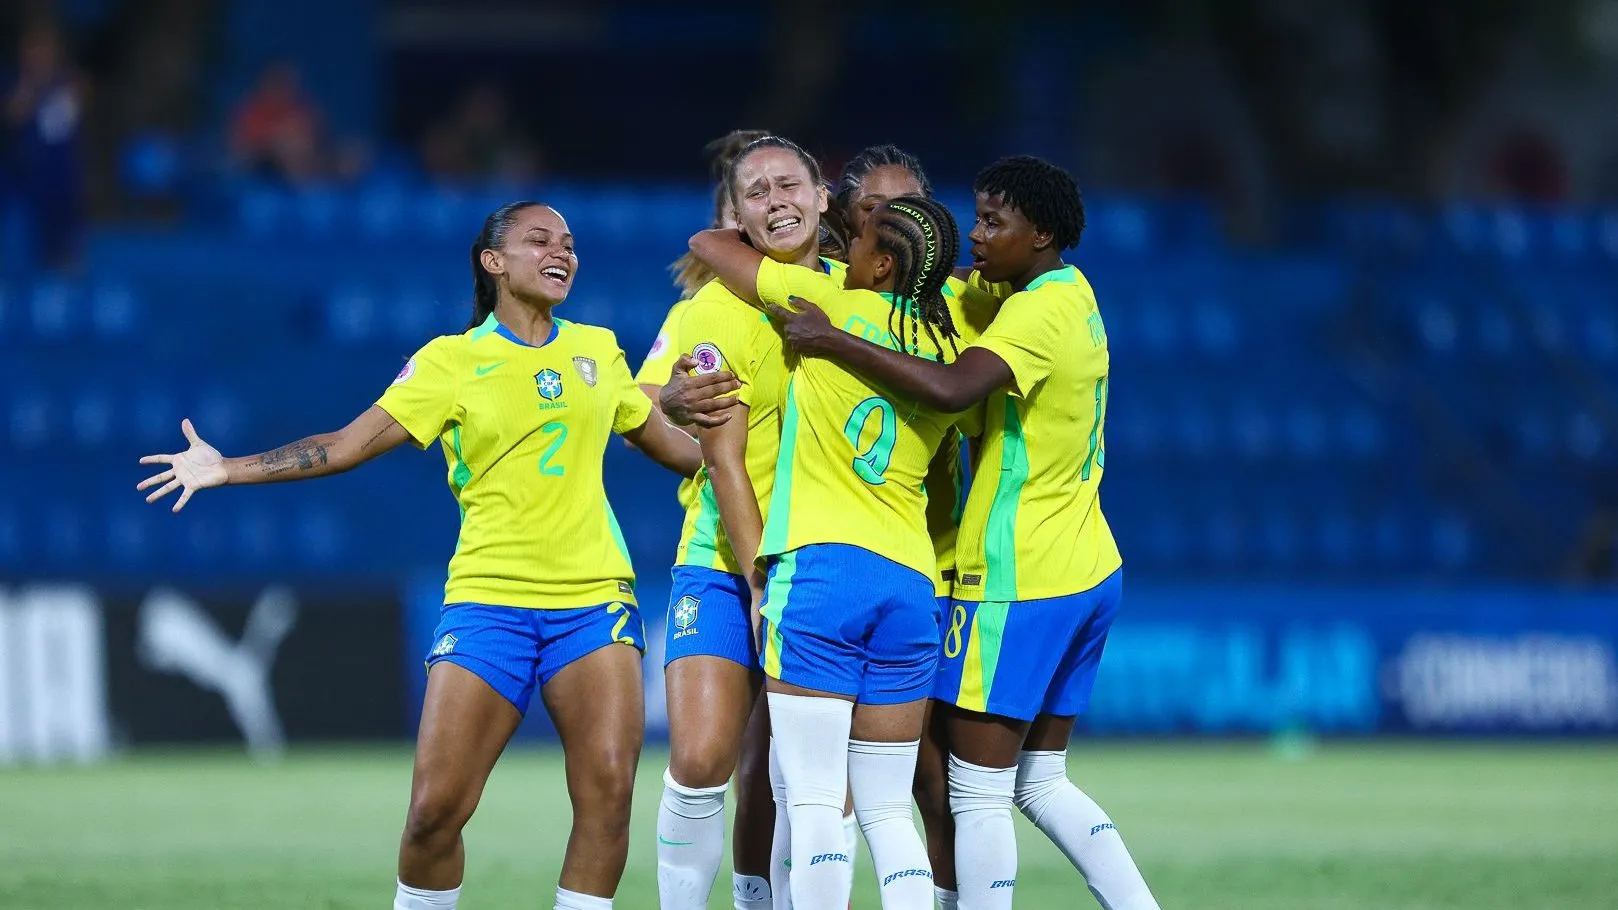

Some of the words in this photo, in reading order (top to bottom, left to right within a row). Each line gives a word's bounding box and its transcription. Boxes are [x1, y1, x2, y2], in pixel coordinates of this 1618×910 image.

[539, 422, 567, 476] 2
[606, 601, 635, 645] 2
[673, 628, 699, 640] BRASIL
[944, 605, 967, 659] 8
